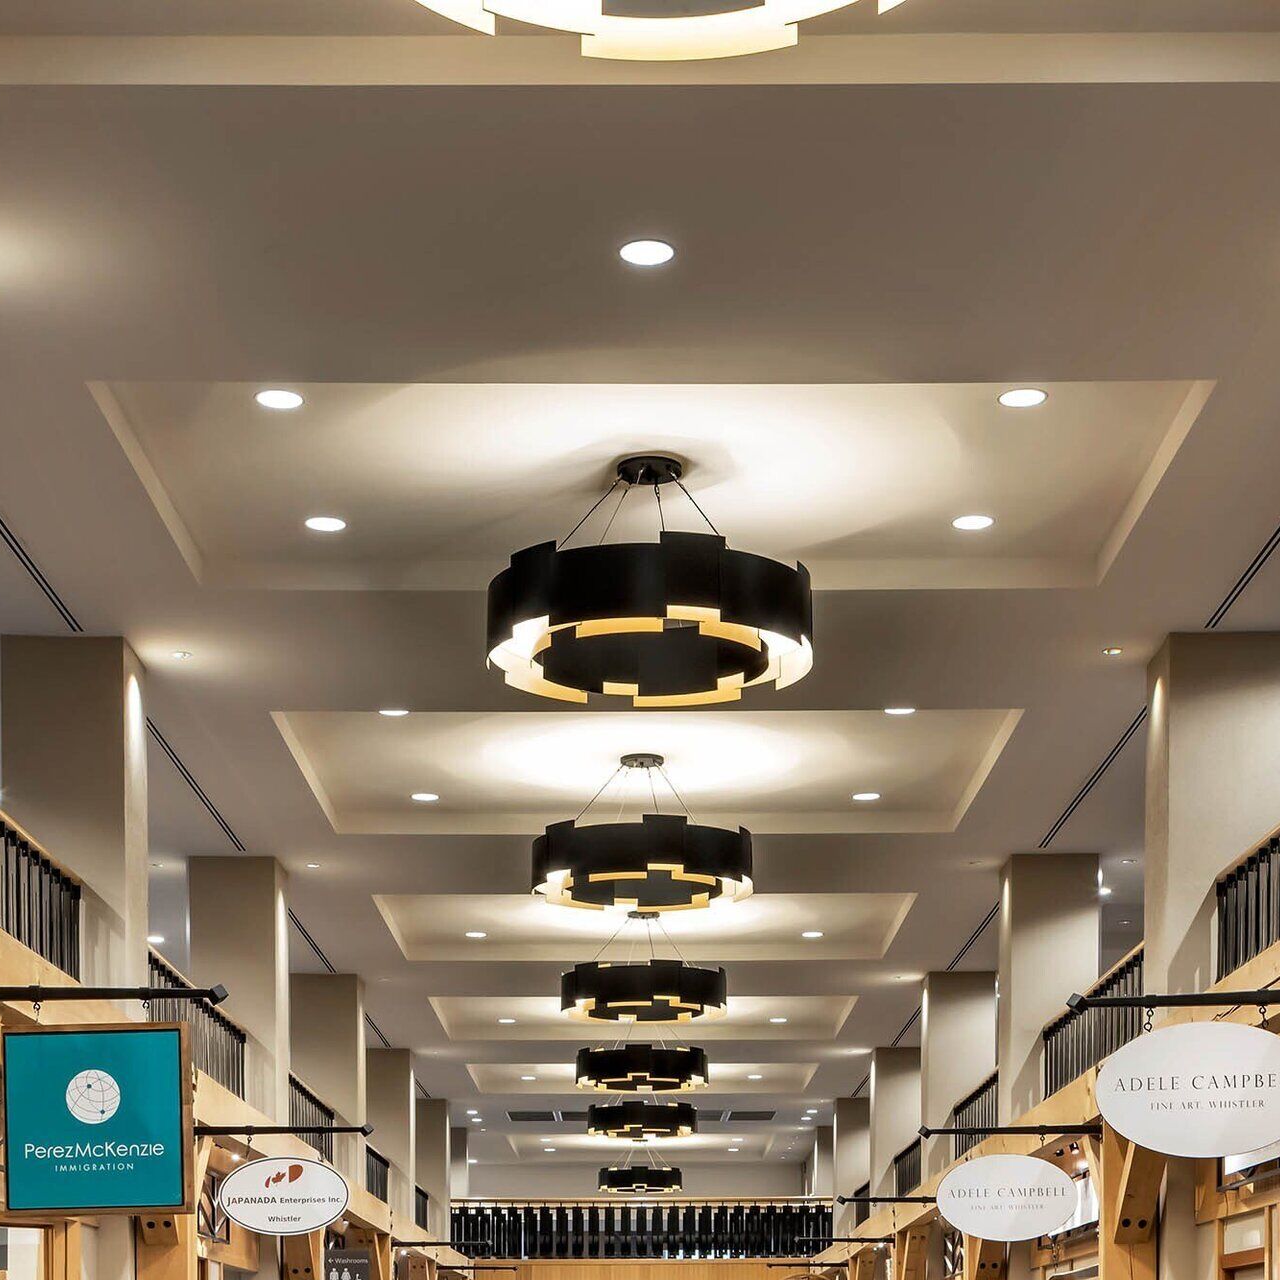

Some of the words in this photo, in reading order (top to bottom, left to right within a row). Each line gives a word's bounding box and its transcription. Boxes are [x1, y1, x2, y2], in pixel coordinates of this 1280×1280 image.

[1114, 1075, 1180, 1093] ADELE
[1150, 1101, 1173, 1111] FINE
[1208, 1098, 1266, 1109] WHISTLER
[24, 1141, 165, 1159] PerezMcKenzie
[54, 1162, 135, 1173] IMMIGRATION
[947, 1188, 991, 1199] ADELE
[997, 1186, 1069, 1198] CAMPBELL
[226, 1196, 277, 1207] JAPANADA
[279, 1196, 326, 1205] Enterprises
[328, 1195, 343, 1204] Inc.
[267, 1215, 302, 1223] Whistler
[334, 1257, 369, 1265] Washrooms
